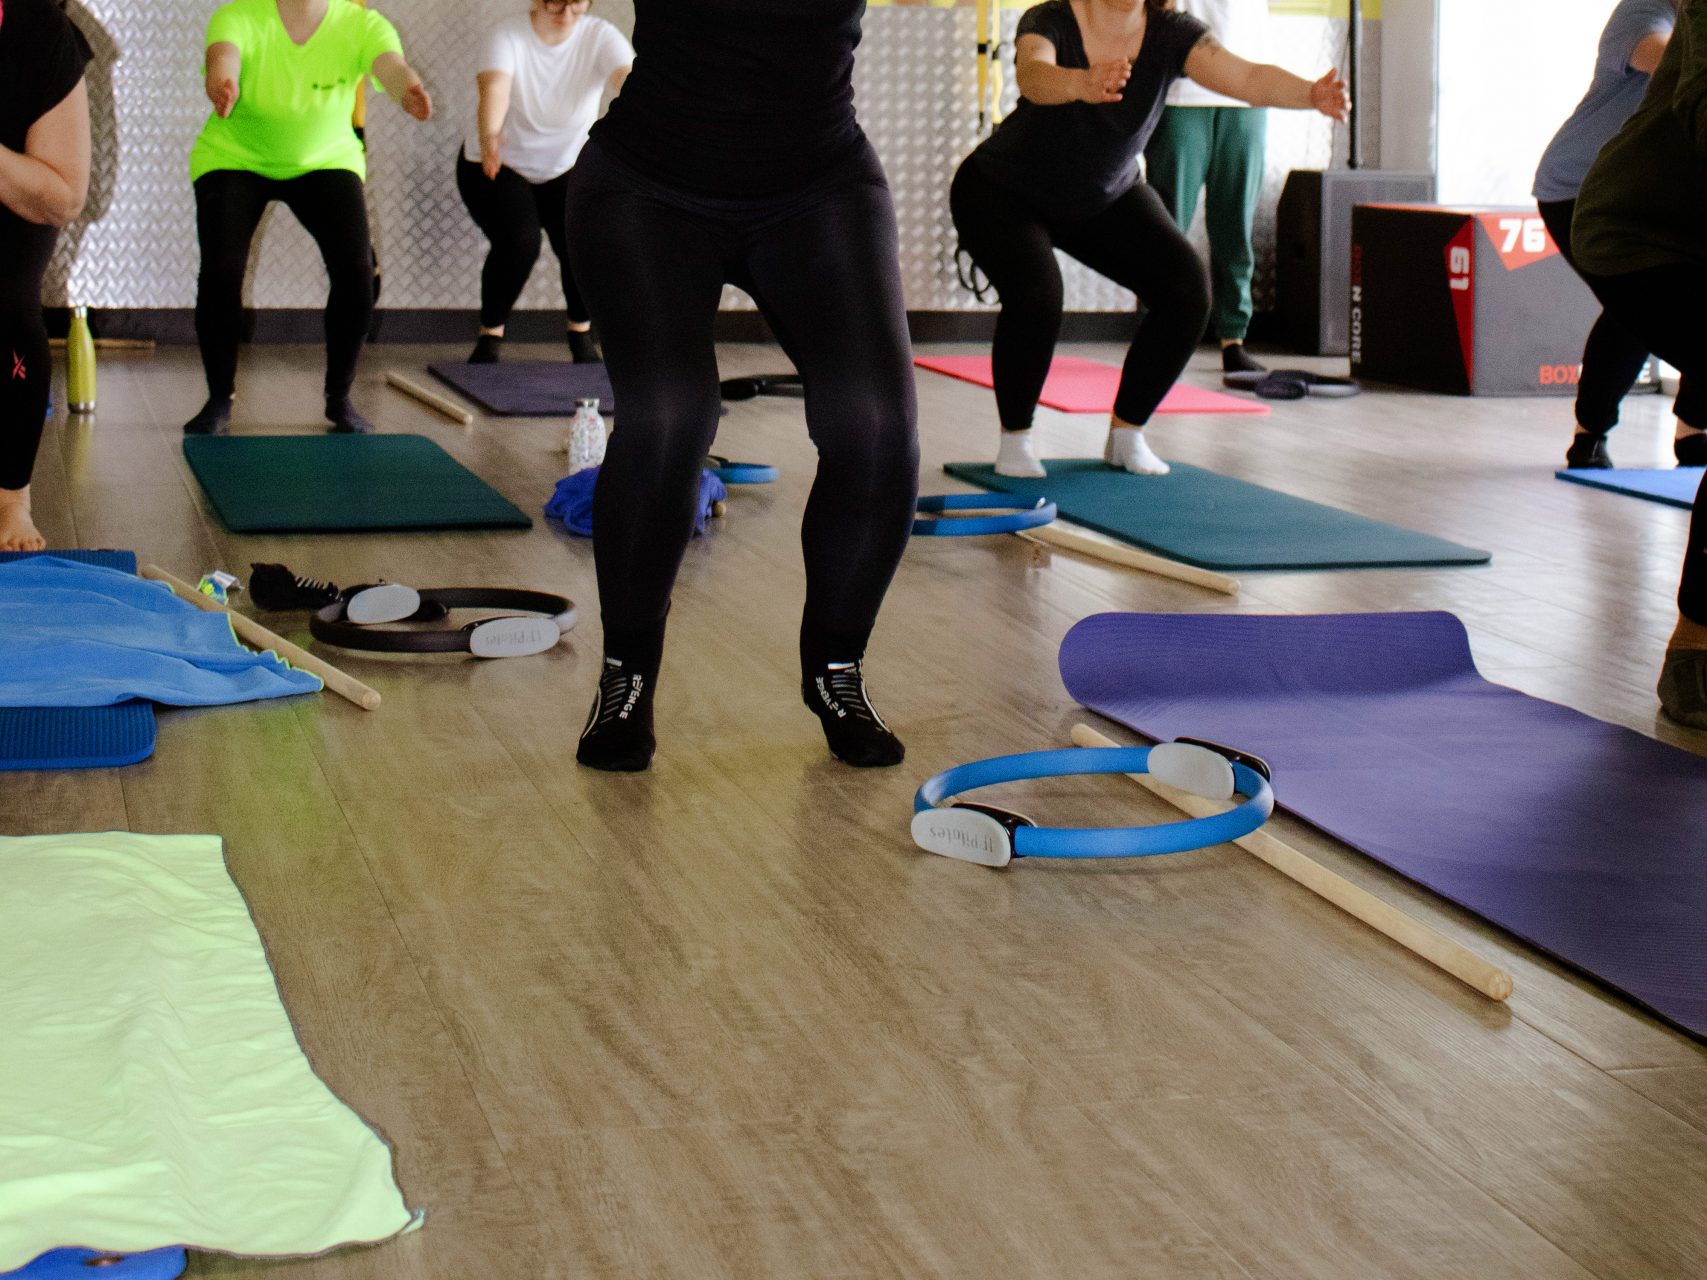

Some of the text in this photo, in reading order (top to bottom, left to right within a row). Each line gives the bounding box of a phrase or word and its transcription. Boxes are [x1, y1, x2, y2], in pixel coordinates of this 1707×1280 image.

[1499, 218, 1546, 253] 76
[1449, 246, 1470, 291] 61
[1539, 364, 1583, 385] BOX
